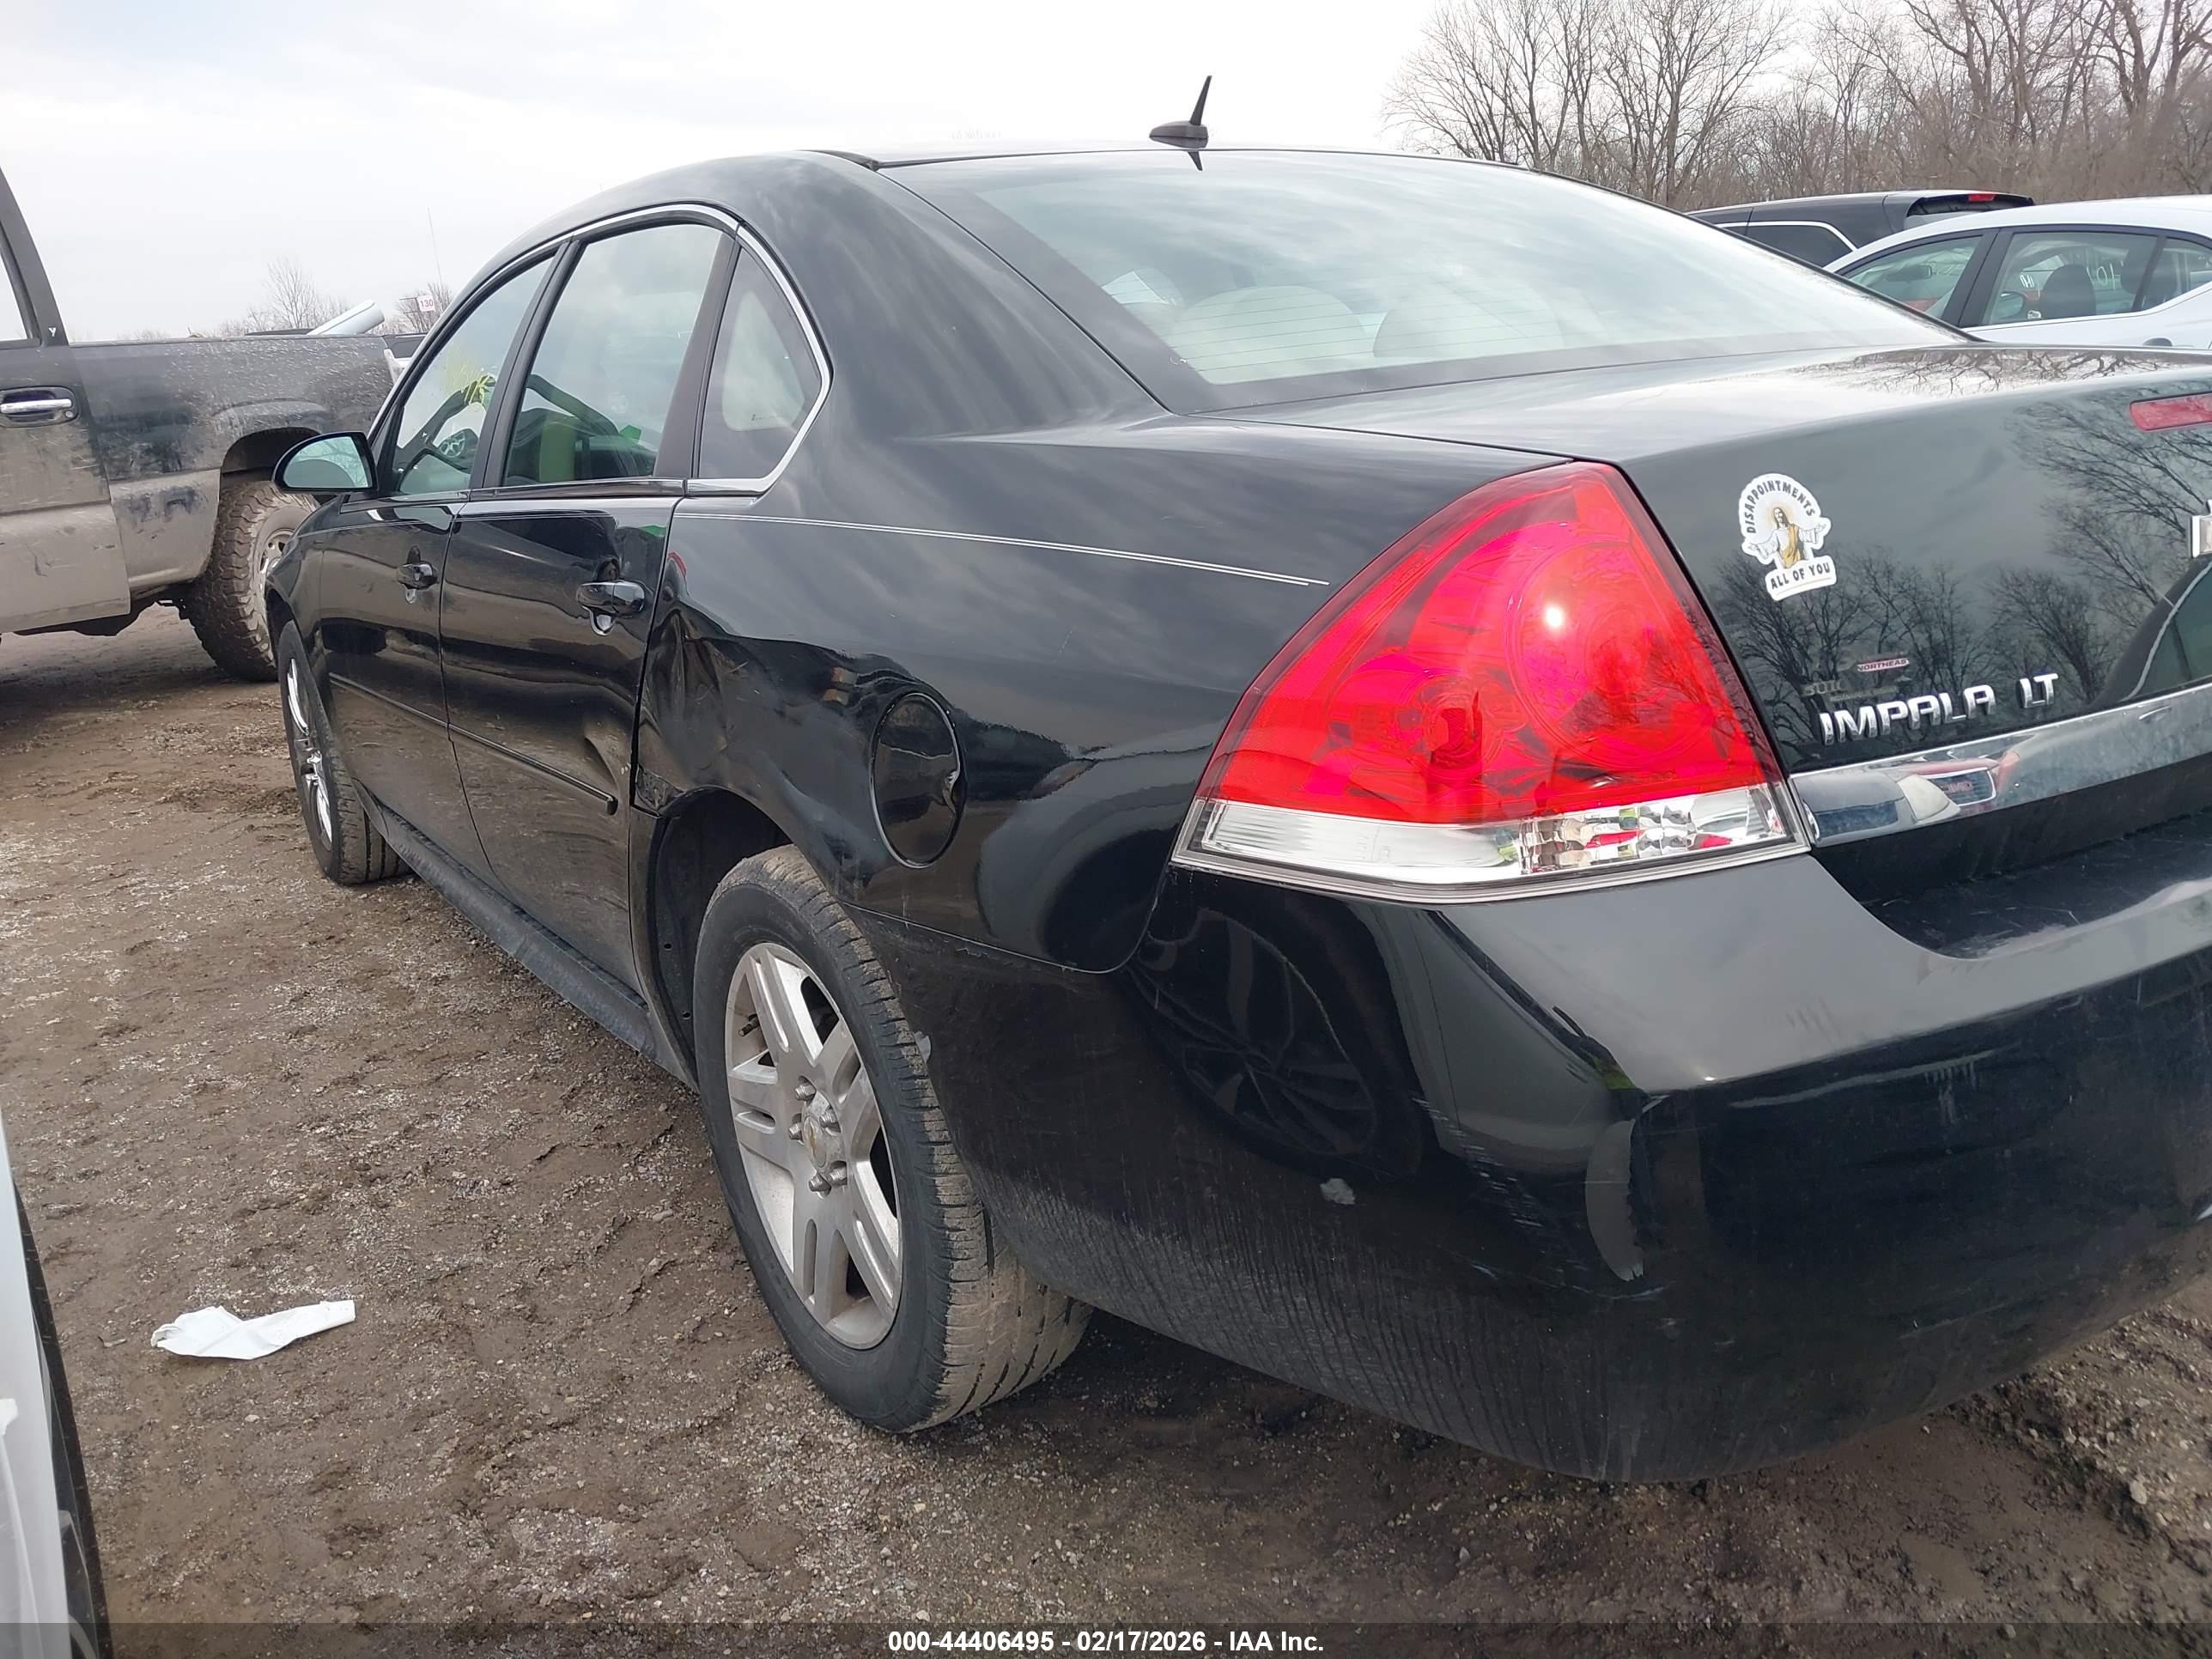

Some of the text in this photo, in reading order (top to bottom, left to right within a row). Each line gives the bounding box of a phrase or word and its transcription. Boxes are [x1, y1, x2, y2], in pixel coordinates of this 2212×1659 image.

[420, 299, 434, 307] 130
[1744, 480, 1816, 534] DISAPPOINTMENTS
[1770, 562, 1831, 590] ALL OF YOU
[1819, 672, 2059, 746] IMPALA LT
